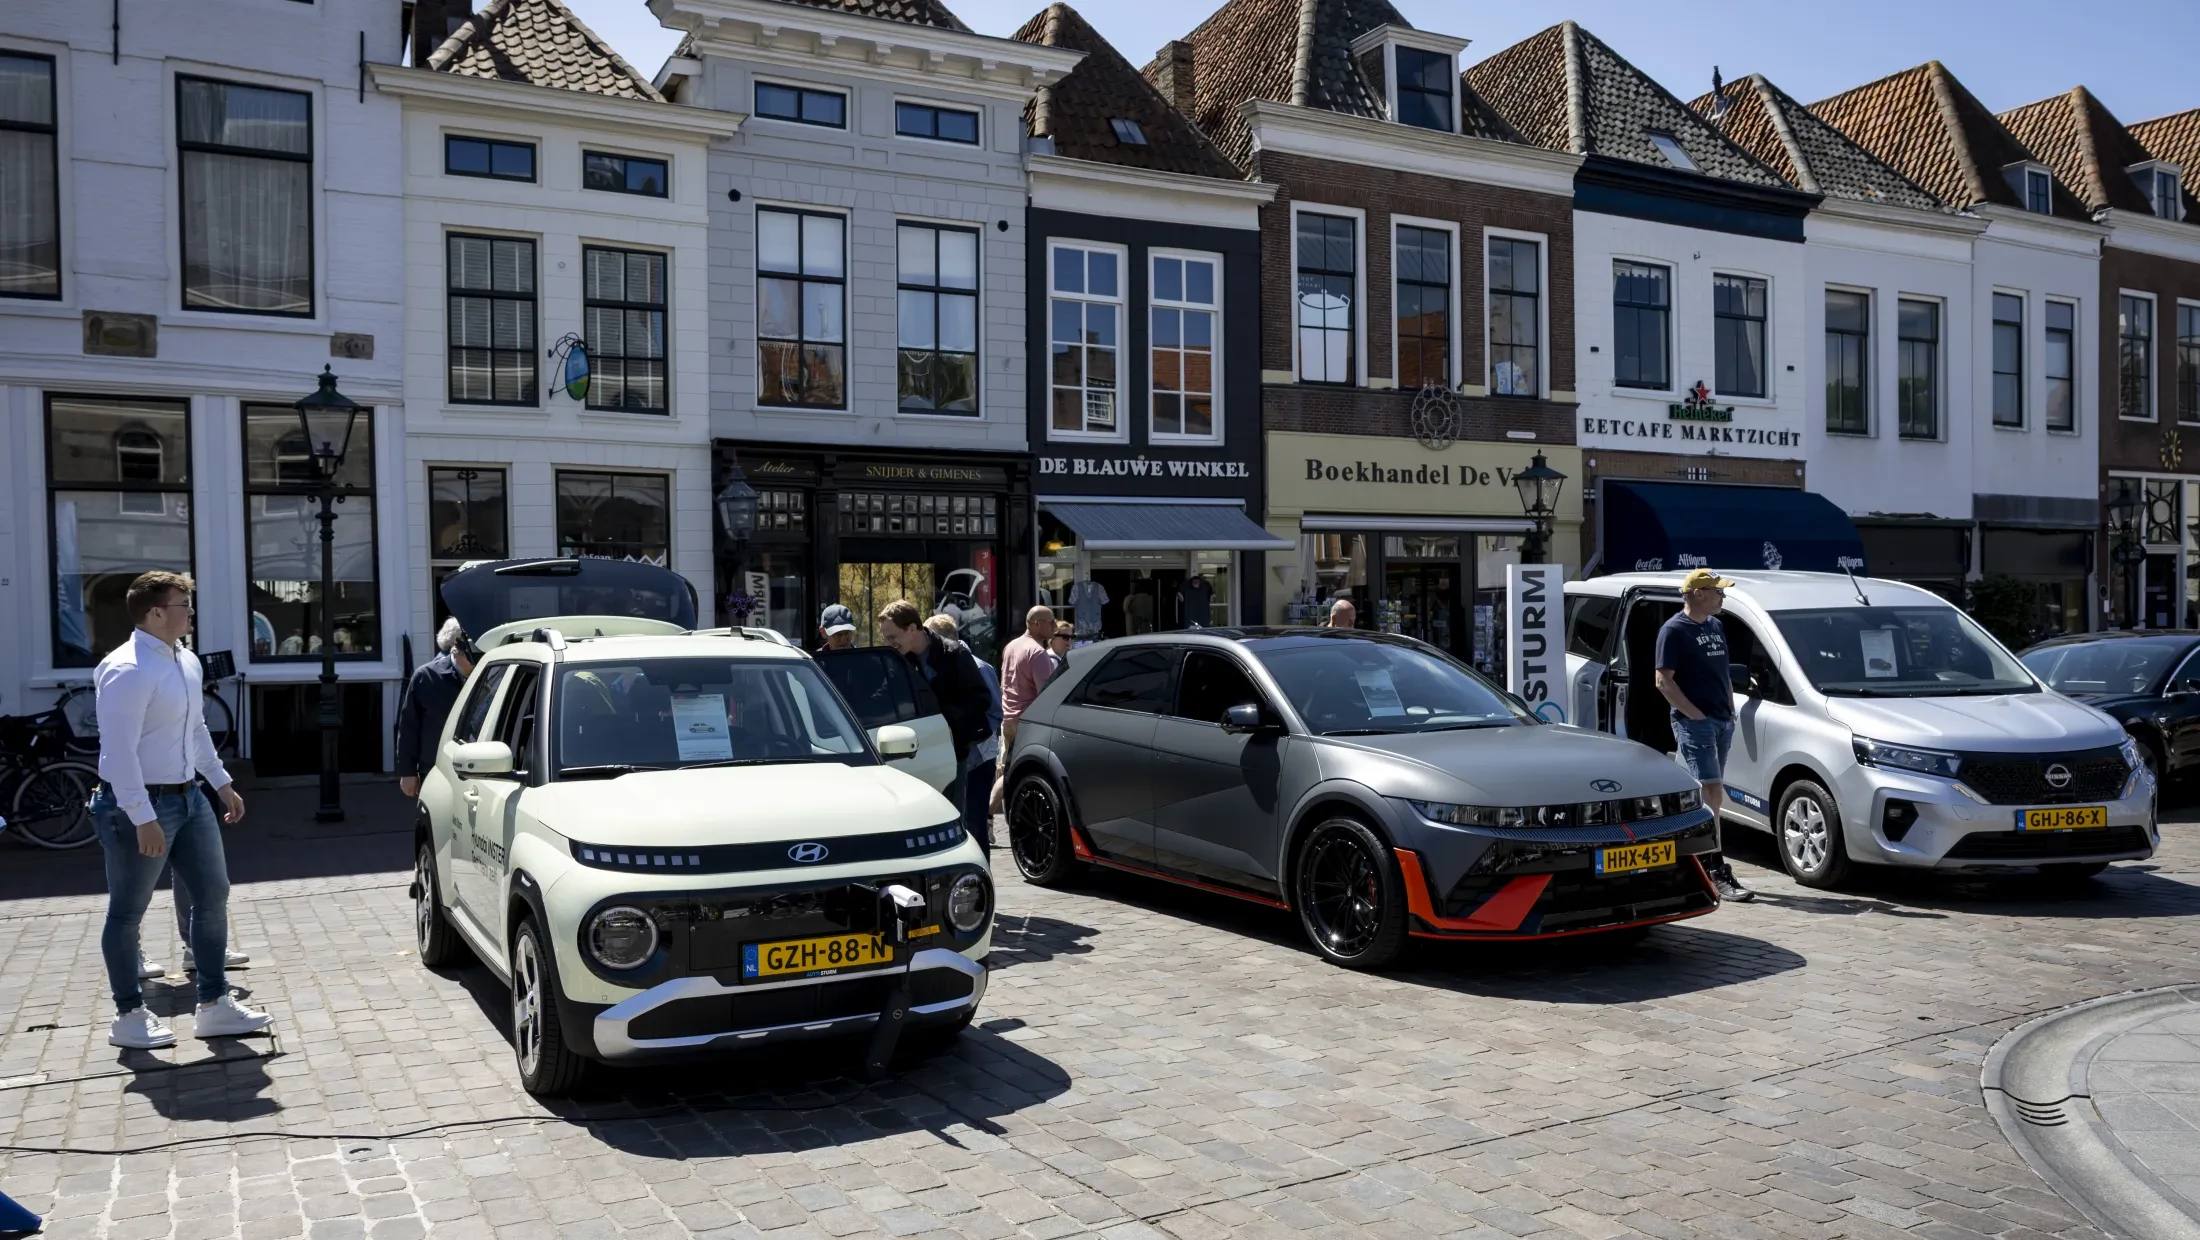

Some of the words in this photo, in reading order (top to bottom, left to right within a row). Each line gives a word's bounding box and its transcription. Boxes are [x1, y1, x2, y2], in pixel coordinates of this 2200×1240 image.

[1671, 404, 1732, 422] Heineken
[1584, 418, 1672, 439] EETCAFE
[1682, 425, 1801, 447] MARKTZICHT
[754, 461, 795, 474] Atelier
[866, 465, 914, 479] SNIJDER
[919, 468, 927, 478] &
[930, 468, 981, 480] GIMENES
[1039, 457, 1068, 474] DE
[1073, 459, 1163, 476] BLAUWE
[1167, 461, 1249, 477] WINKEL
[1305, 459, 1450, 485] Boekhandel
[1459, 465, 1490, 486] De
[1522, 570, 1548, 702] STURM
[2030, 809, 2101, 827] GHJ-86-X
[488, 839, 506, 866] INSTER
[1607, 844, 1672, 870] HHX-45-V
[746, 964, 757, 972] NL
[767, 936, 886, 971] GZH-88-N
